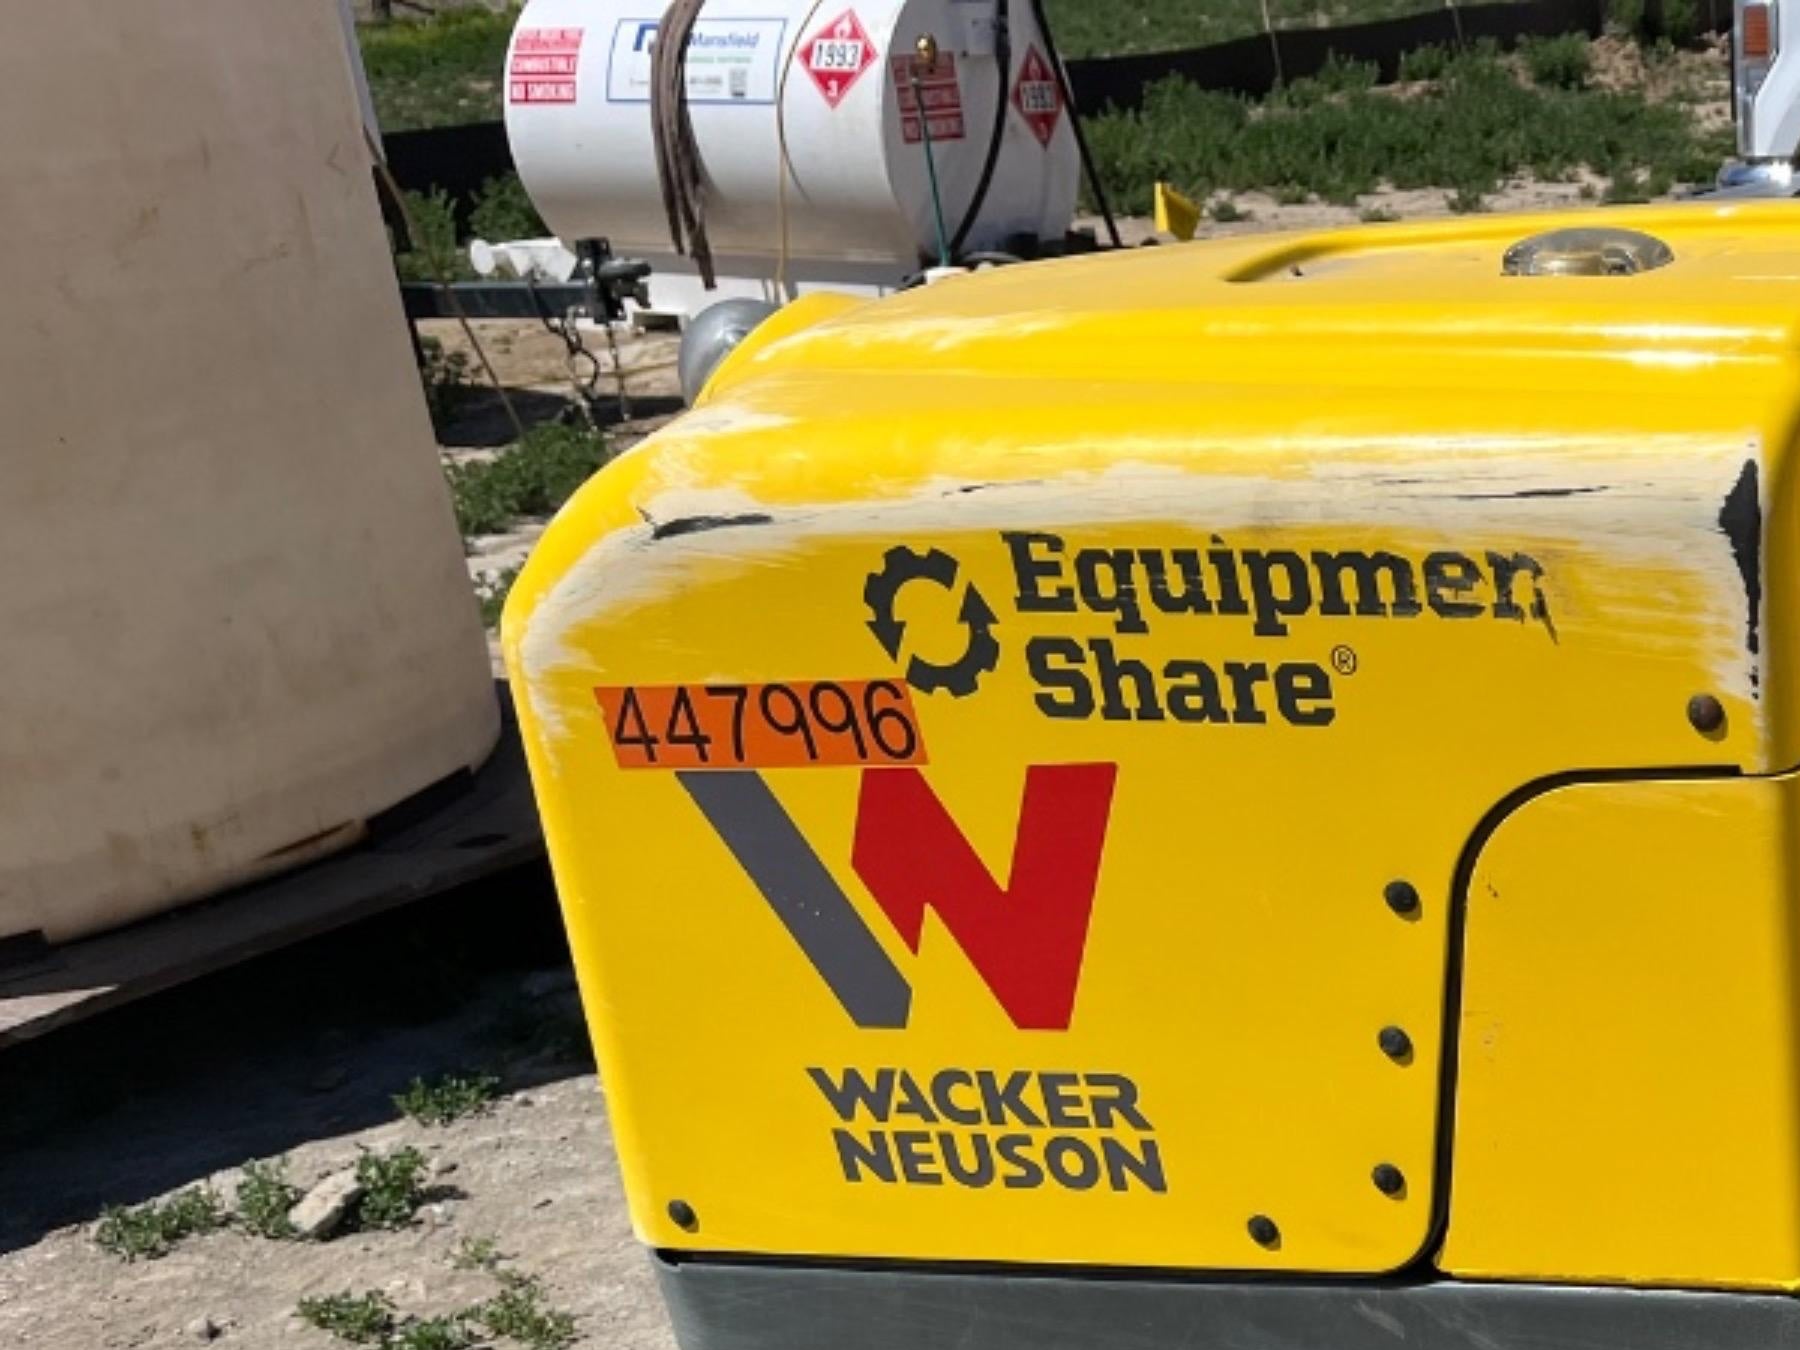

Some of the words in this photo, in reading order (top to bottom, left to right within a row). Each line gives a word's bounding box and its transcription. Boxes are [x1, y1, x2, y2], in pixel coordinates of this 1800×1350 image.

[815, 43, 859, 68] 1993
[826, 79, 839, 98] 3
[1001, 531, 1556, 640] Equipmen
[613, 679, 917, 763] 447996
[805, 1067, 1156, 1132] WACKER
[831, 1128, 1169, 1193] NEUSON
